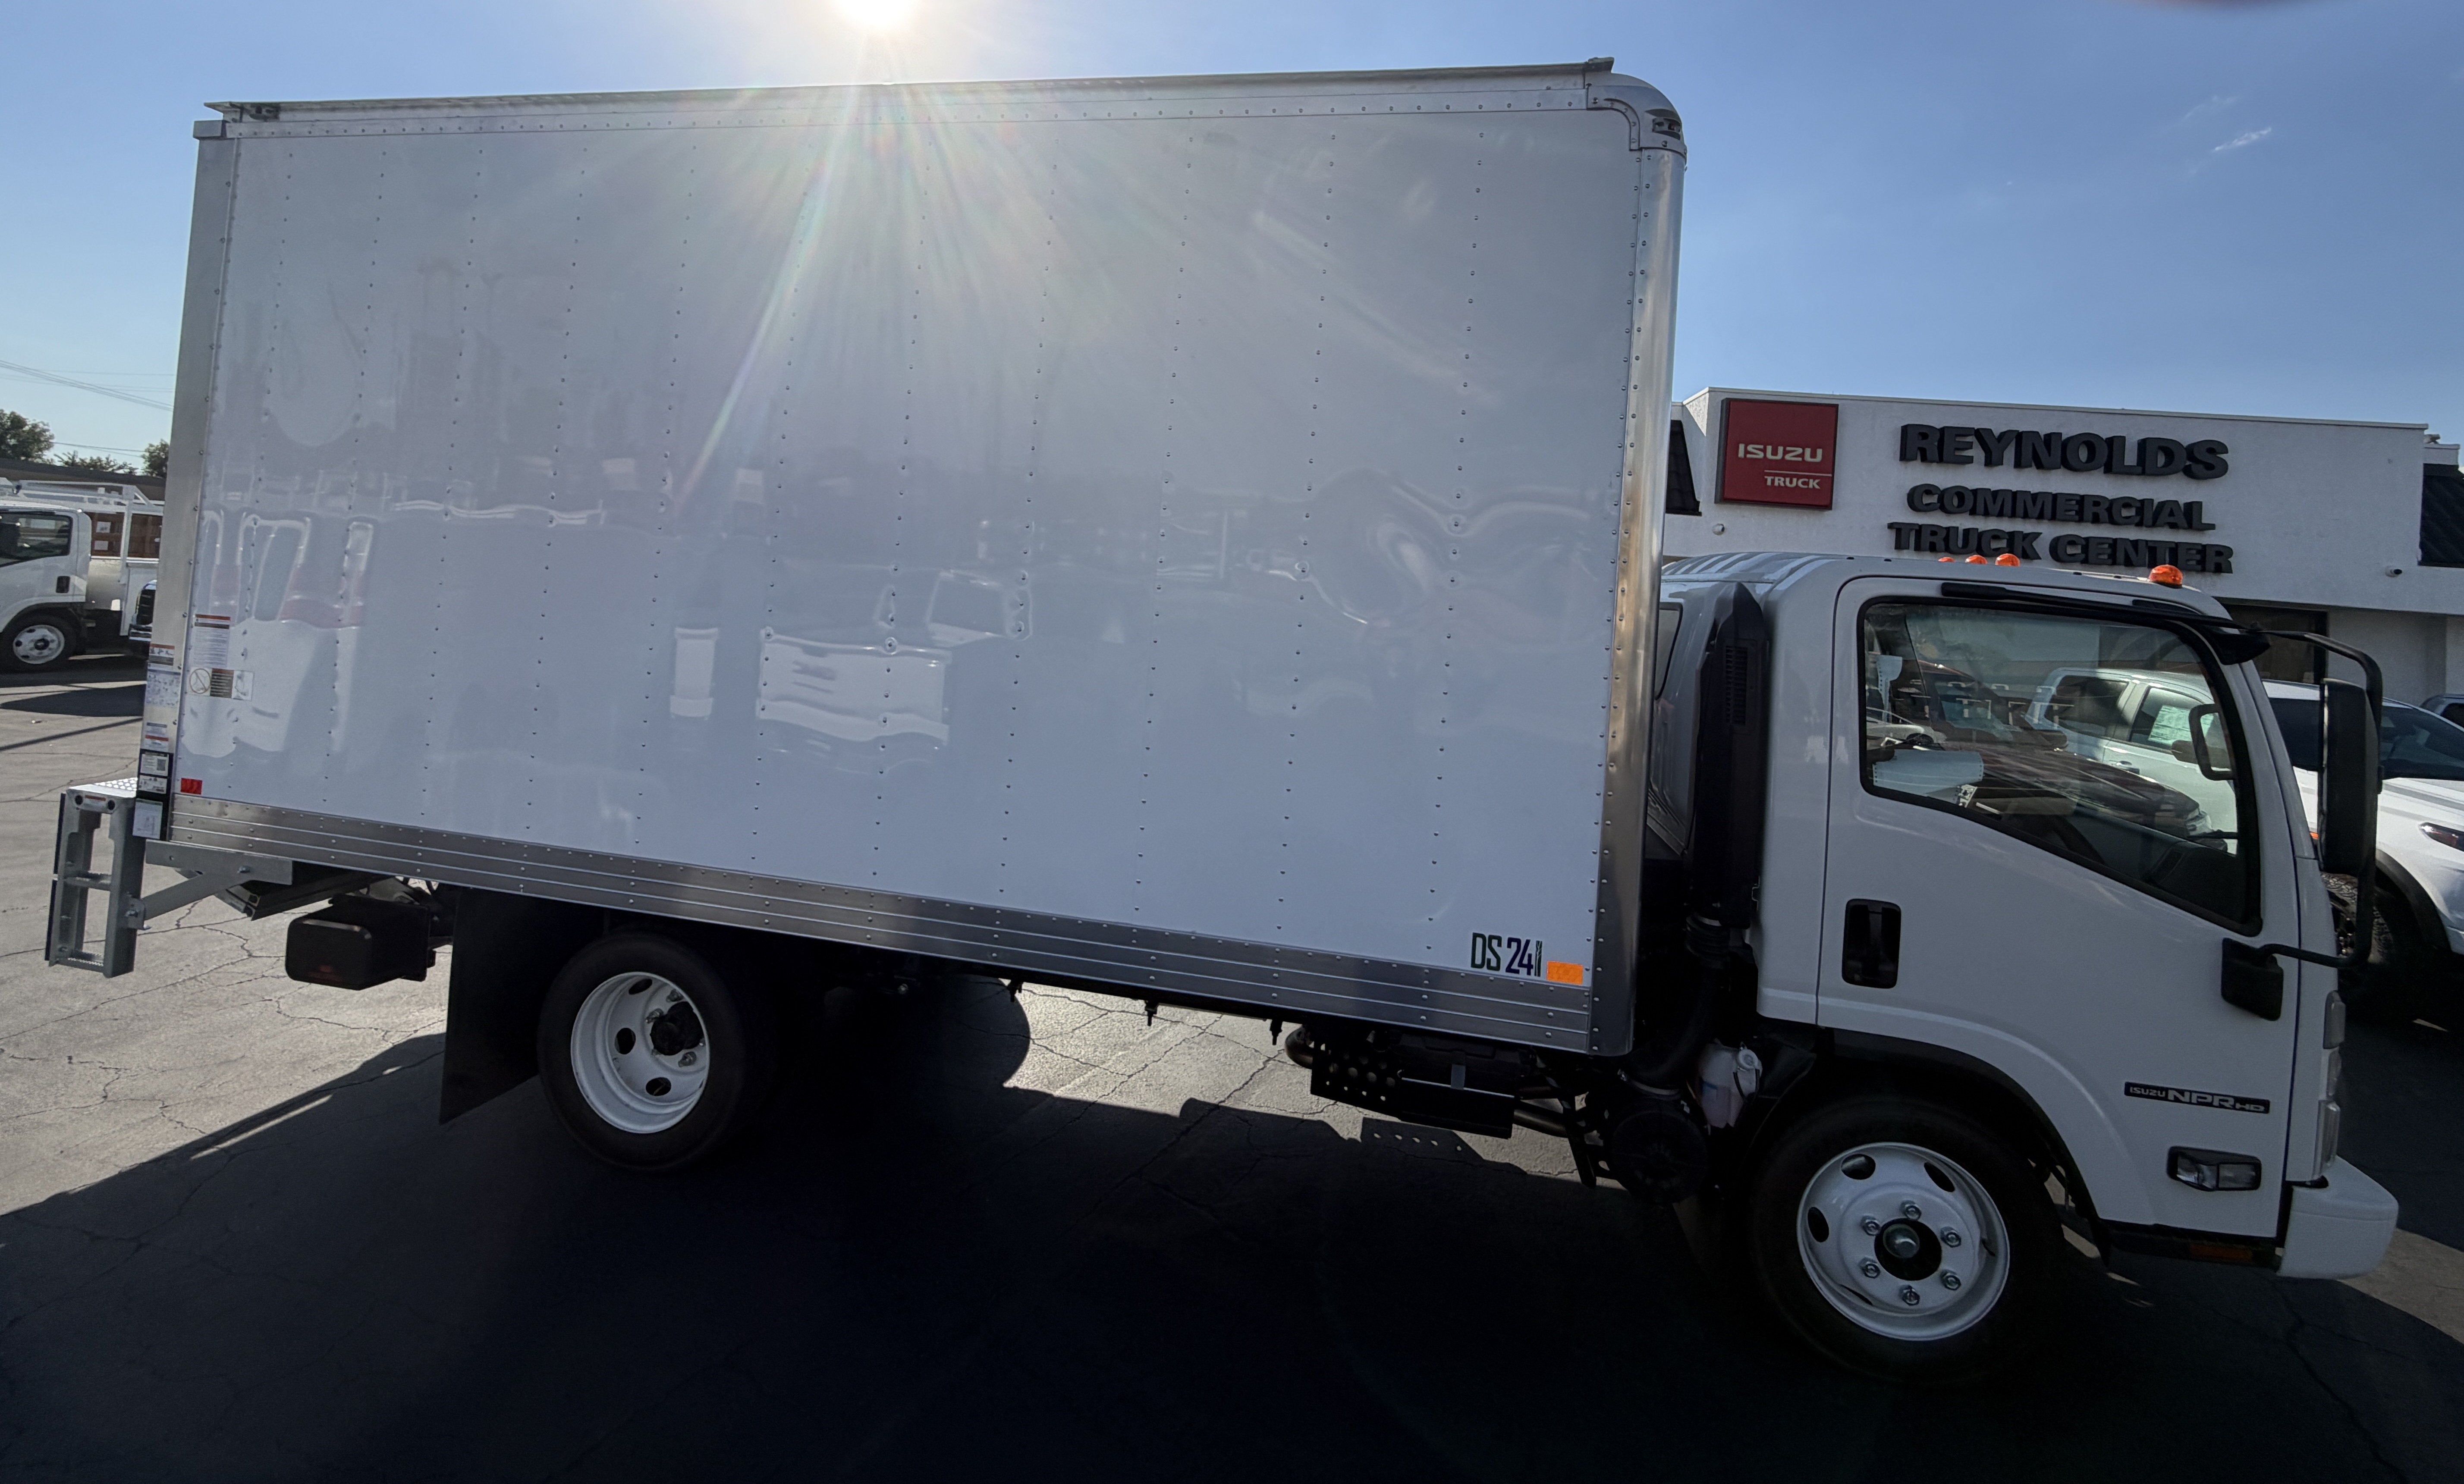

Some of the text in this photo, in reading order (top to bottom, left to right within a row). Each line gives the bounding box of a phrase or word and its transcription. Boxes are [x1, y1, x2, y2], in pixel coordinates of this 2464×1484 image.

[1738, 443, 1823, 462] ISUZU
[1899, 424, 2228, 480] REYNOLDS
[1764, 476, 1821, 489] TRUCK
[1907, 483, 2216, 530] COMMERCIAL
[1887, 522, 2233, 574] TRUCK CENTER
[1471, 932, 1502, 971] DS
[2129, 1086, 2265, 1112] ISUZU NPR HD
